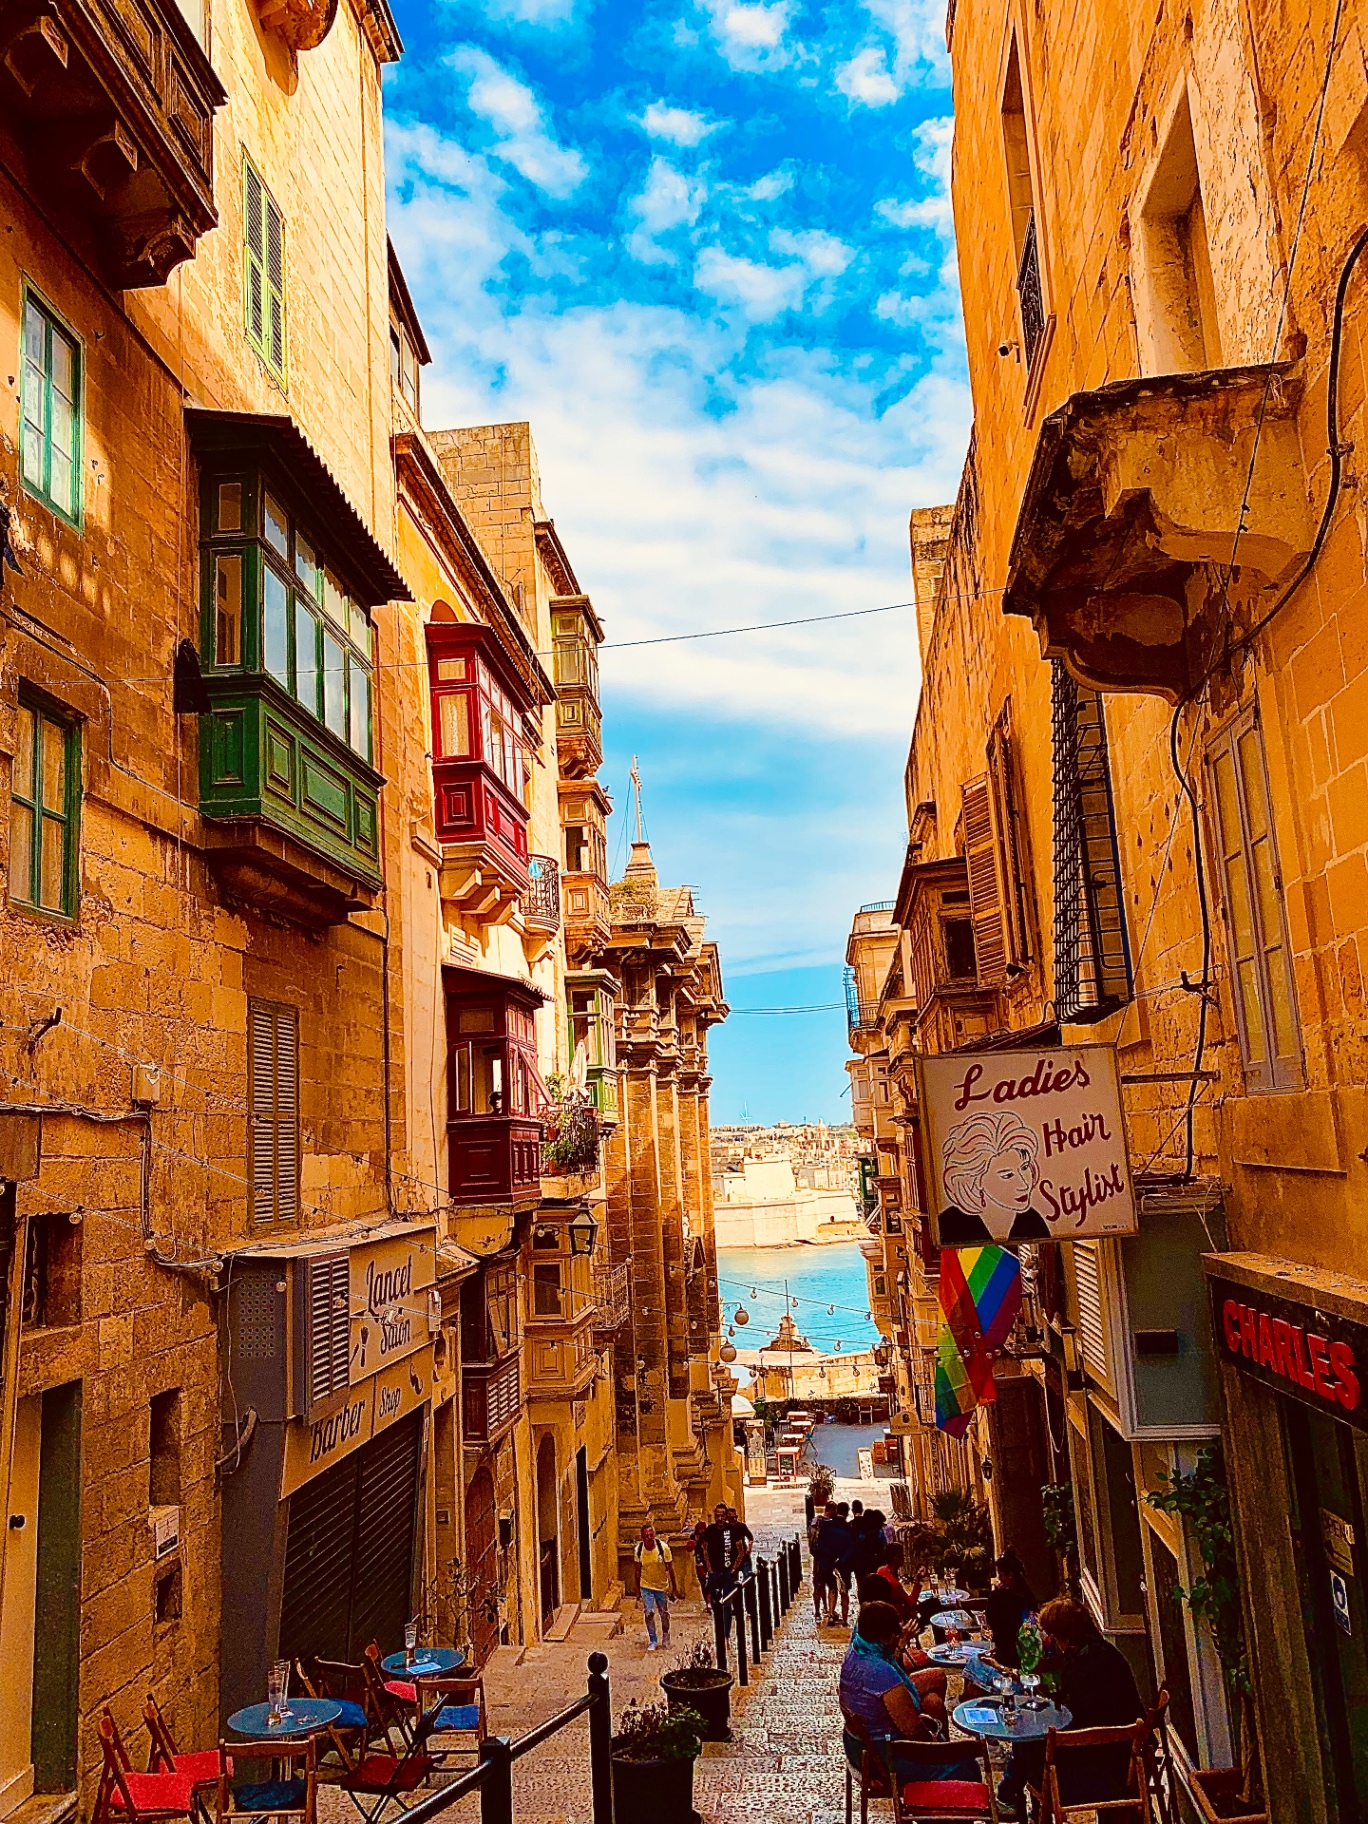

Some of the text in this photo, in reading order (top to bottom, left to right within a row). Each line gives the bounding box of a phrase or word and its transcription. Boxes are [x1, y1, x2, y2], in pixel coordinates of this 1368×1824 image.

[953, 1058, 1091, 1111] Ladies
[1042, 1112, 1112, 1158] Hair
[1039, 1161, 1124, 1228] Stylist
[1223, 1299, 1360, 1411] CHARLES
[309, 1386, 401, 1464] Barber Shop
